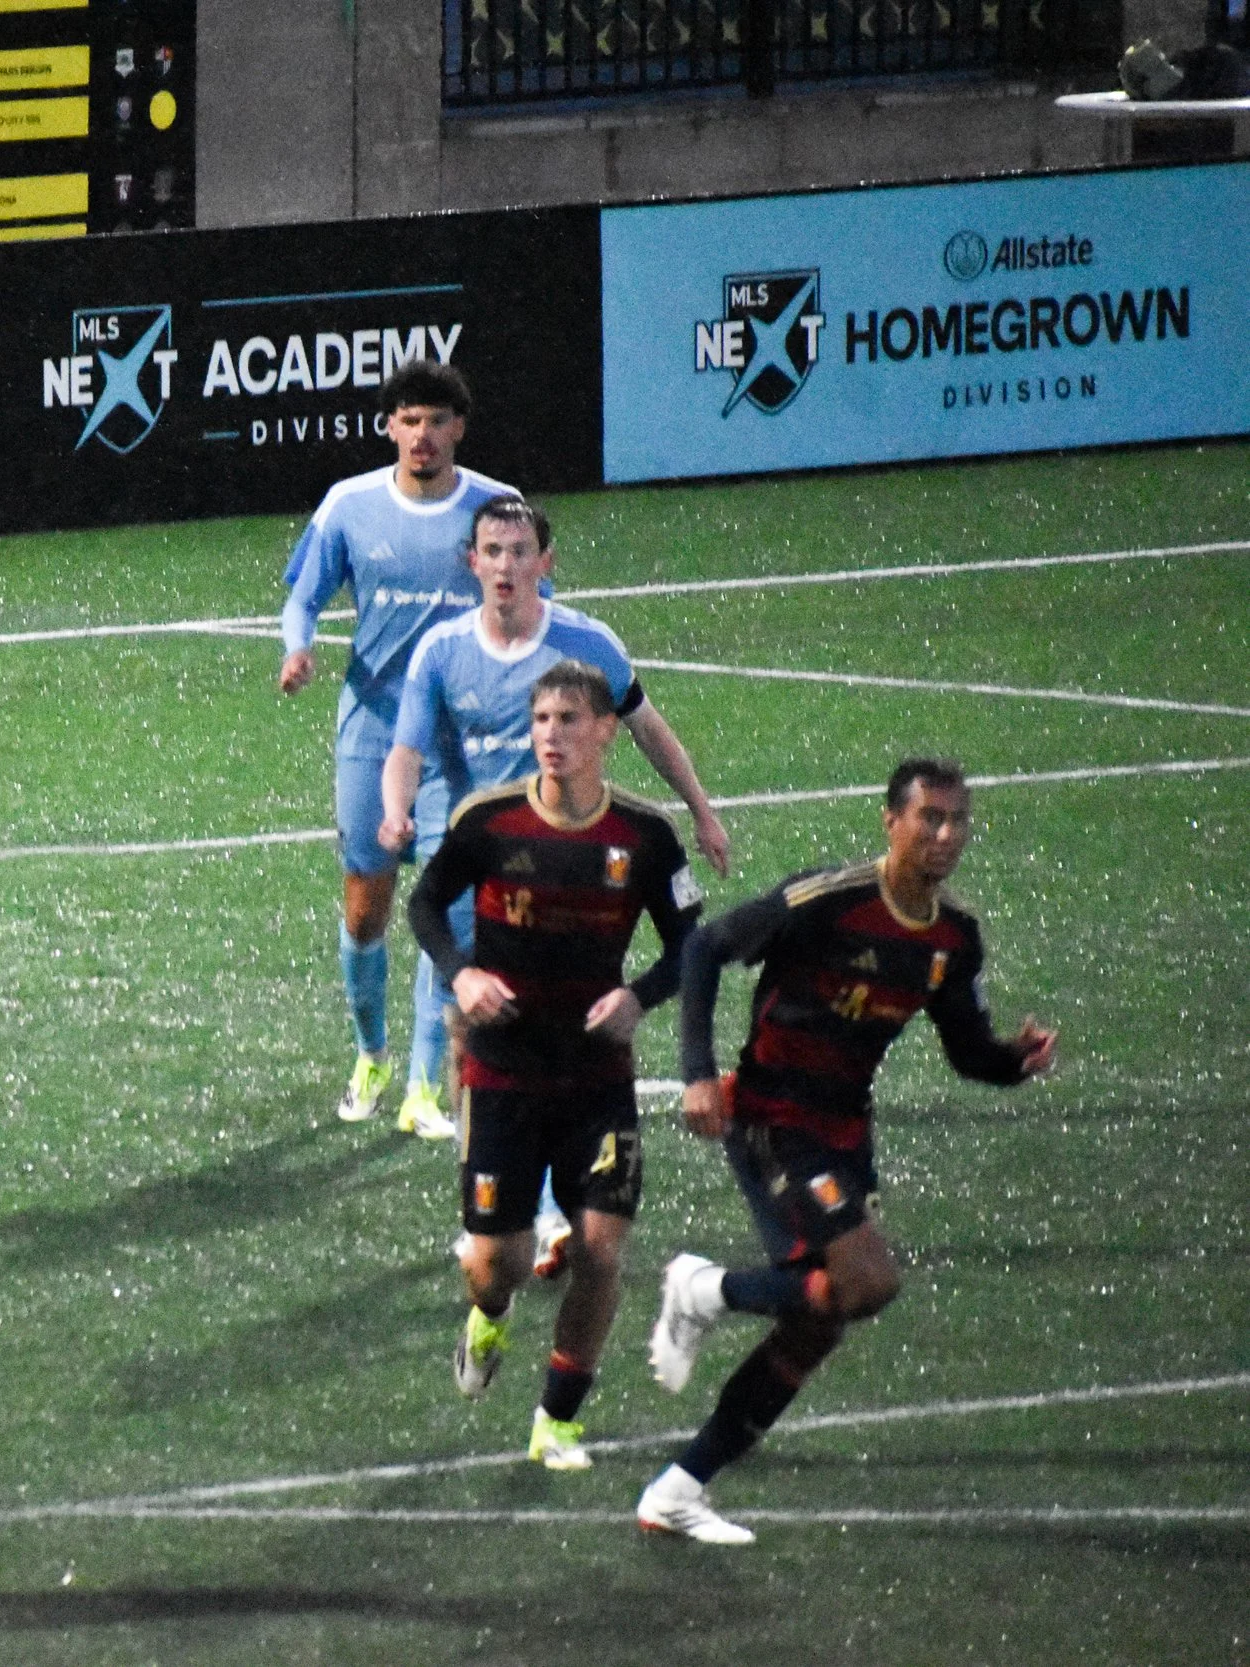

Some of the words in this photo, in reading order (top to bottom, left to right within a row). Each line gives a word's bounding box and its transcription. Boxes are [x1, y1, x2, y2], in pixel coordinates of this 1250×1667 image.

[991, 233, 1094, 273] Allstate
[731, 284, 769, 309] MLS
[79, 317, 120, 342] MLS
[845, 286, 1191, 365] HOMEGROWN
[203, 323, 463, 397] ACADEMY
[942, 375, 1097, 410] DIVISION
[252, 411, 390, 446] DIVISIO
